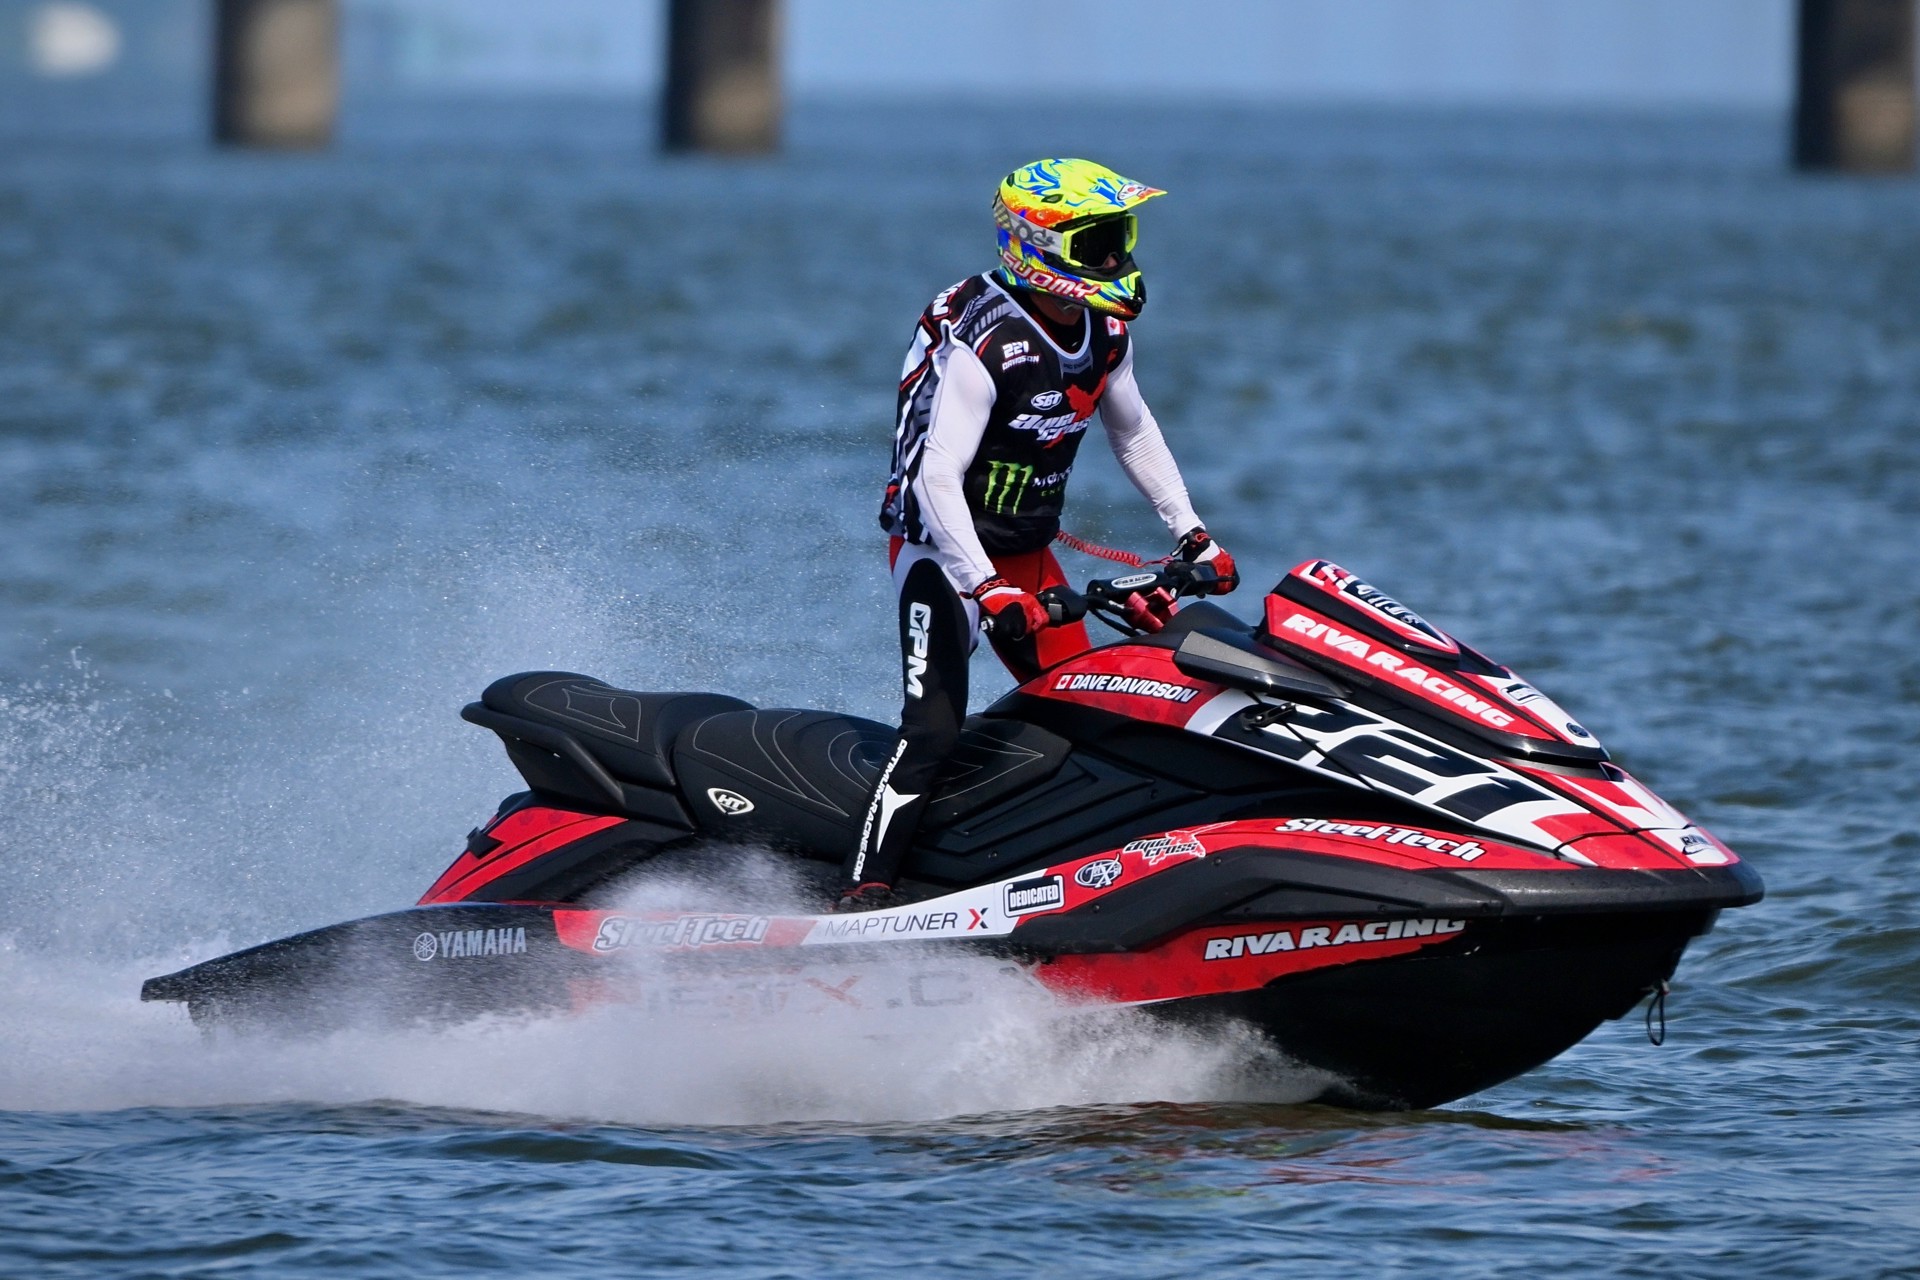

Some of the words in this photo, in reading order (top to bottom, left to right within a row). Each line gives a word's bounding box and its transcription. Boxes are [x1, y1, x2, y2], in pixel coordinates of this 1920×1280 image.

[1000, 250, 1102, 298] SUOMY
[1002, 341, 1029, 359] 221
[1002, 355, 1040, 371] DAVIDSON
[1034, 394, 1061, 407] SBT
[1282, 613, 1370, 659] RIVA
[1366, 650, 1515, 727] RACING
[1069, 674, 1111, 690] DAVE
[1106, 675, 1199, 703] DAVIDSON
[852, 739, 908, 882] OPTIMUM-RACING.COM
[1010, 884, 1059, 908] DEDICATED
[824, 912, 958, 938] MAPTUNER
[966, 907, 989, 930] X
[439, 927, 526, 958] YAMAHA
[1204, 931, 1296, 960] RIVA
[1299, 918, 1466, 949] RACING
